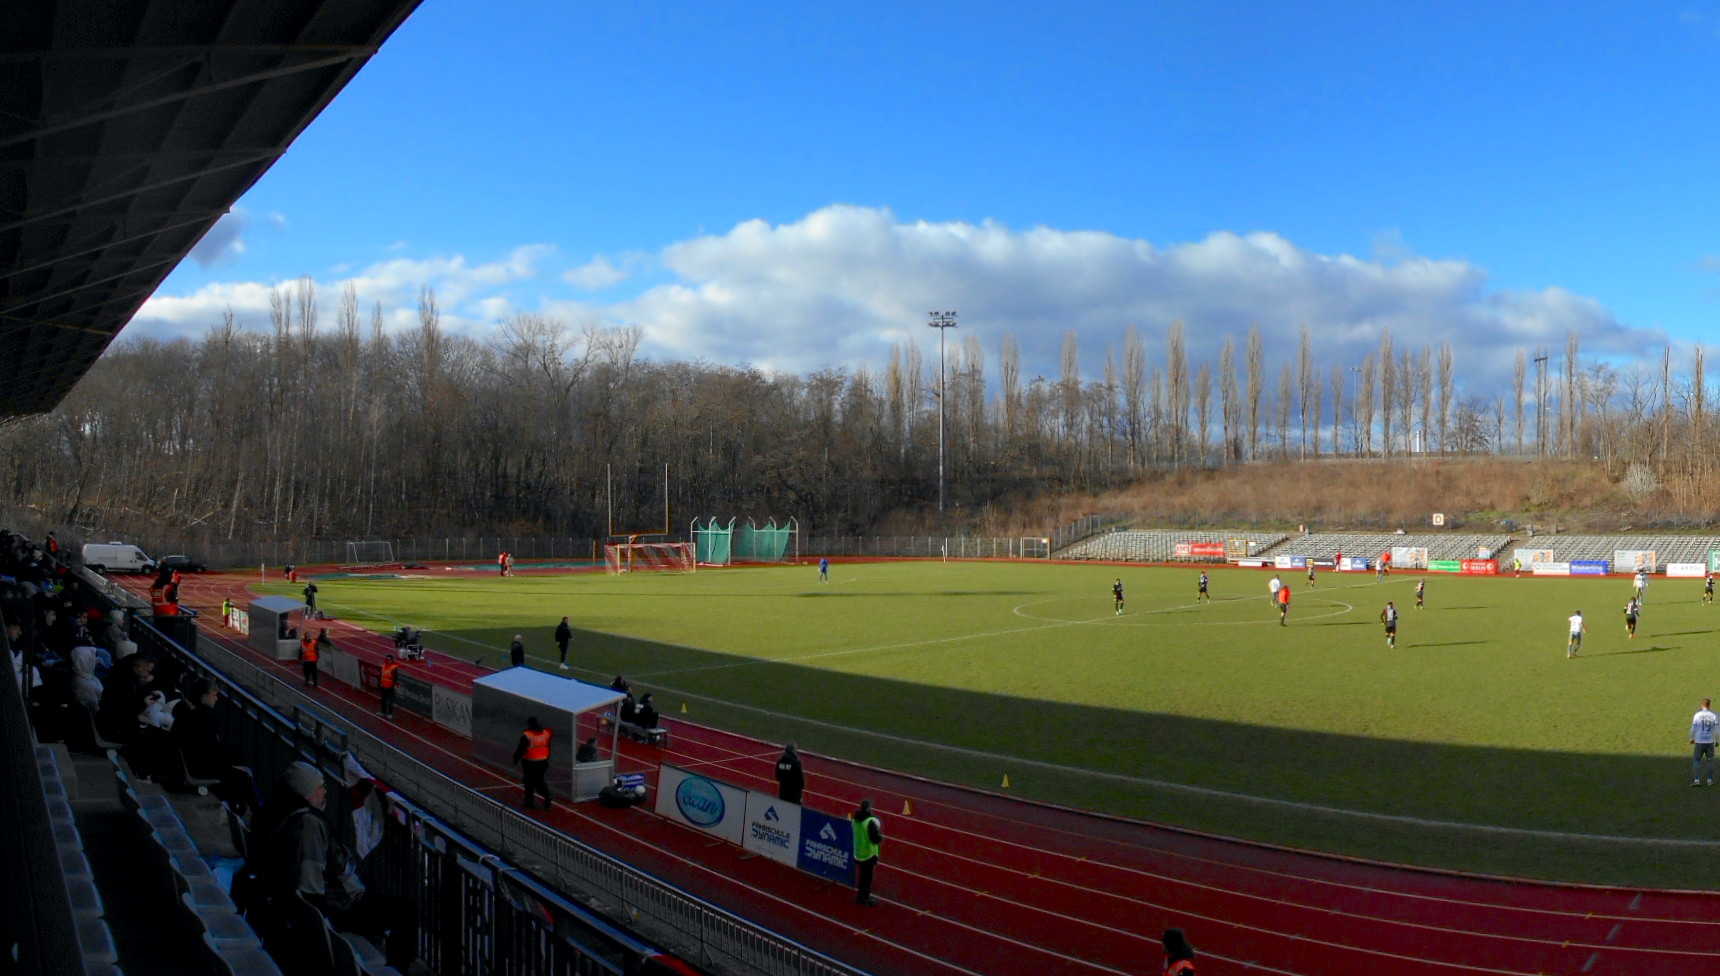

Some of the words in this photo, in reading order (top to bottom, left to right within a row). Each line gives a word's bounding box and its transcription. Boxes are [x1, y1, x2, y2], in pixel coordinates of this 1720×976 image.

[1701, 719, 1711, 732] 19
[751, 827, 790, 849] DYNAMIC
[804, 846, 848, 870] DYNAMIC
